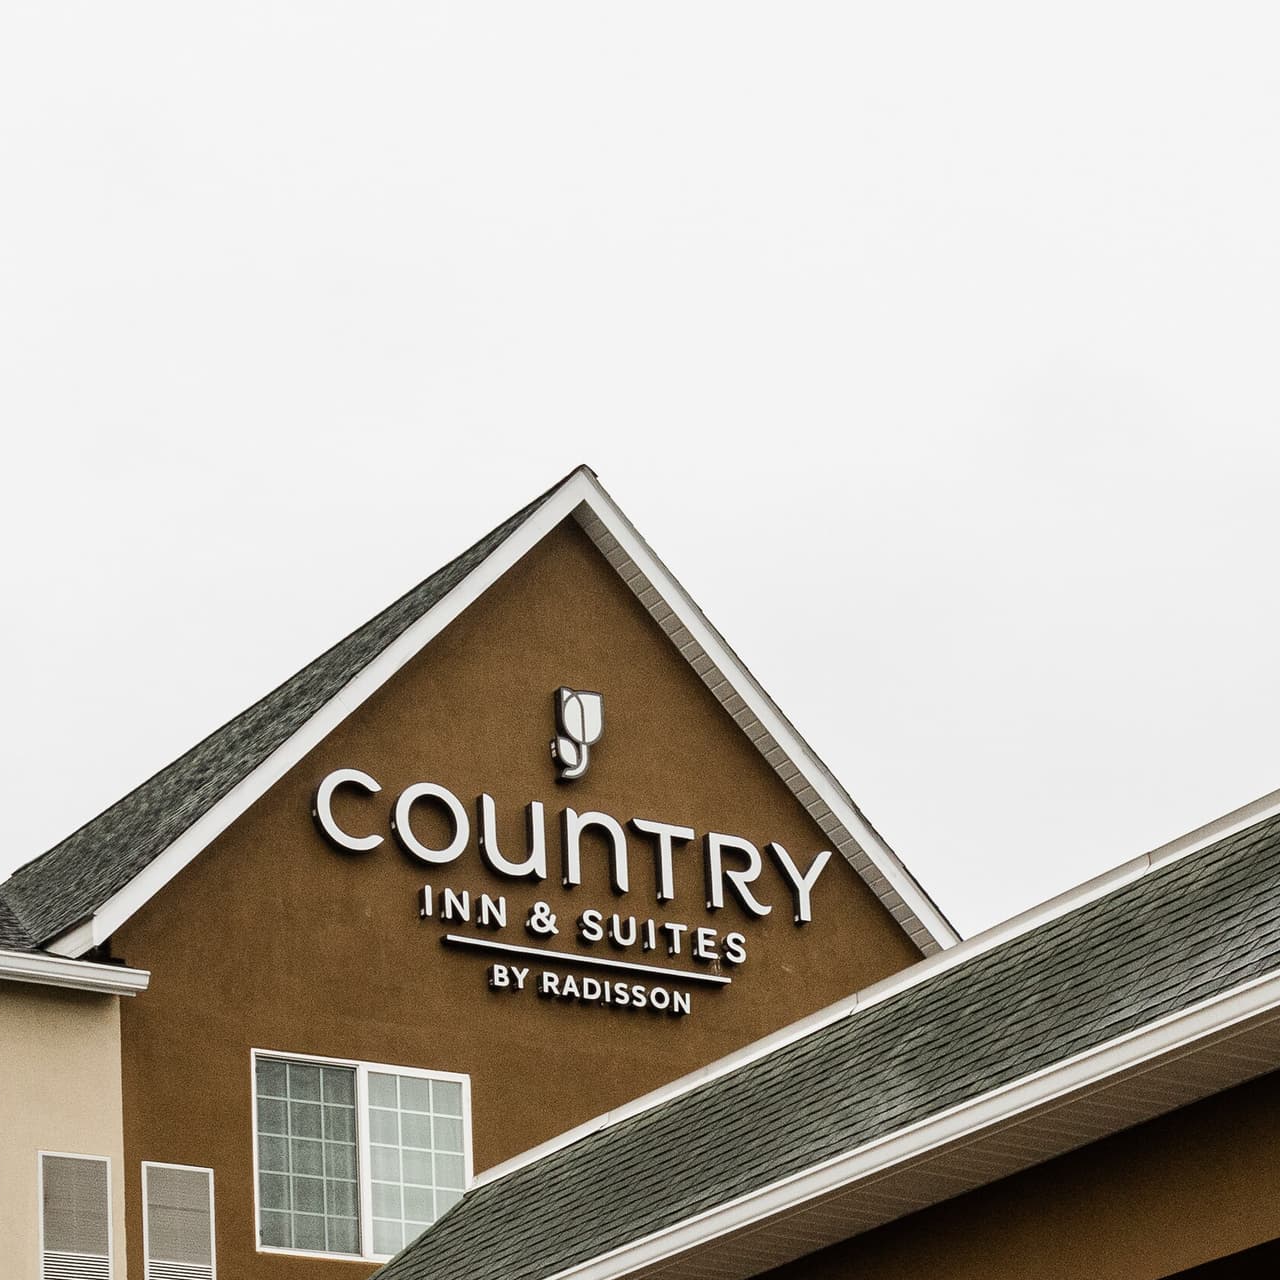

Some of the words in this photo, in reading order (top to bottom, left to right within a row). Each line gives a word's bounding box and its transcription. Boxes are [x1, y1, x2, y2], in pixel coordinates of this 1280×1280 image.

[421, 884, 507, 928] INN
[527, 901, 559, 937] &
[580, 909, 747, 964] SUITES
[490, 964, 529, 990] BY
[539, 972, 691, 1014] RADISSON
